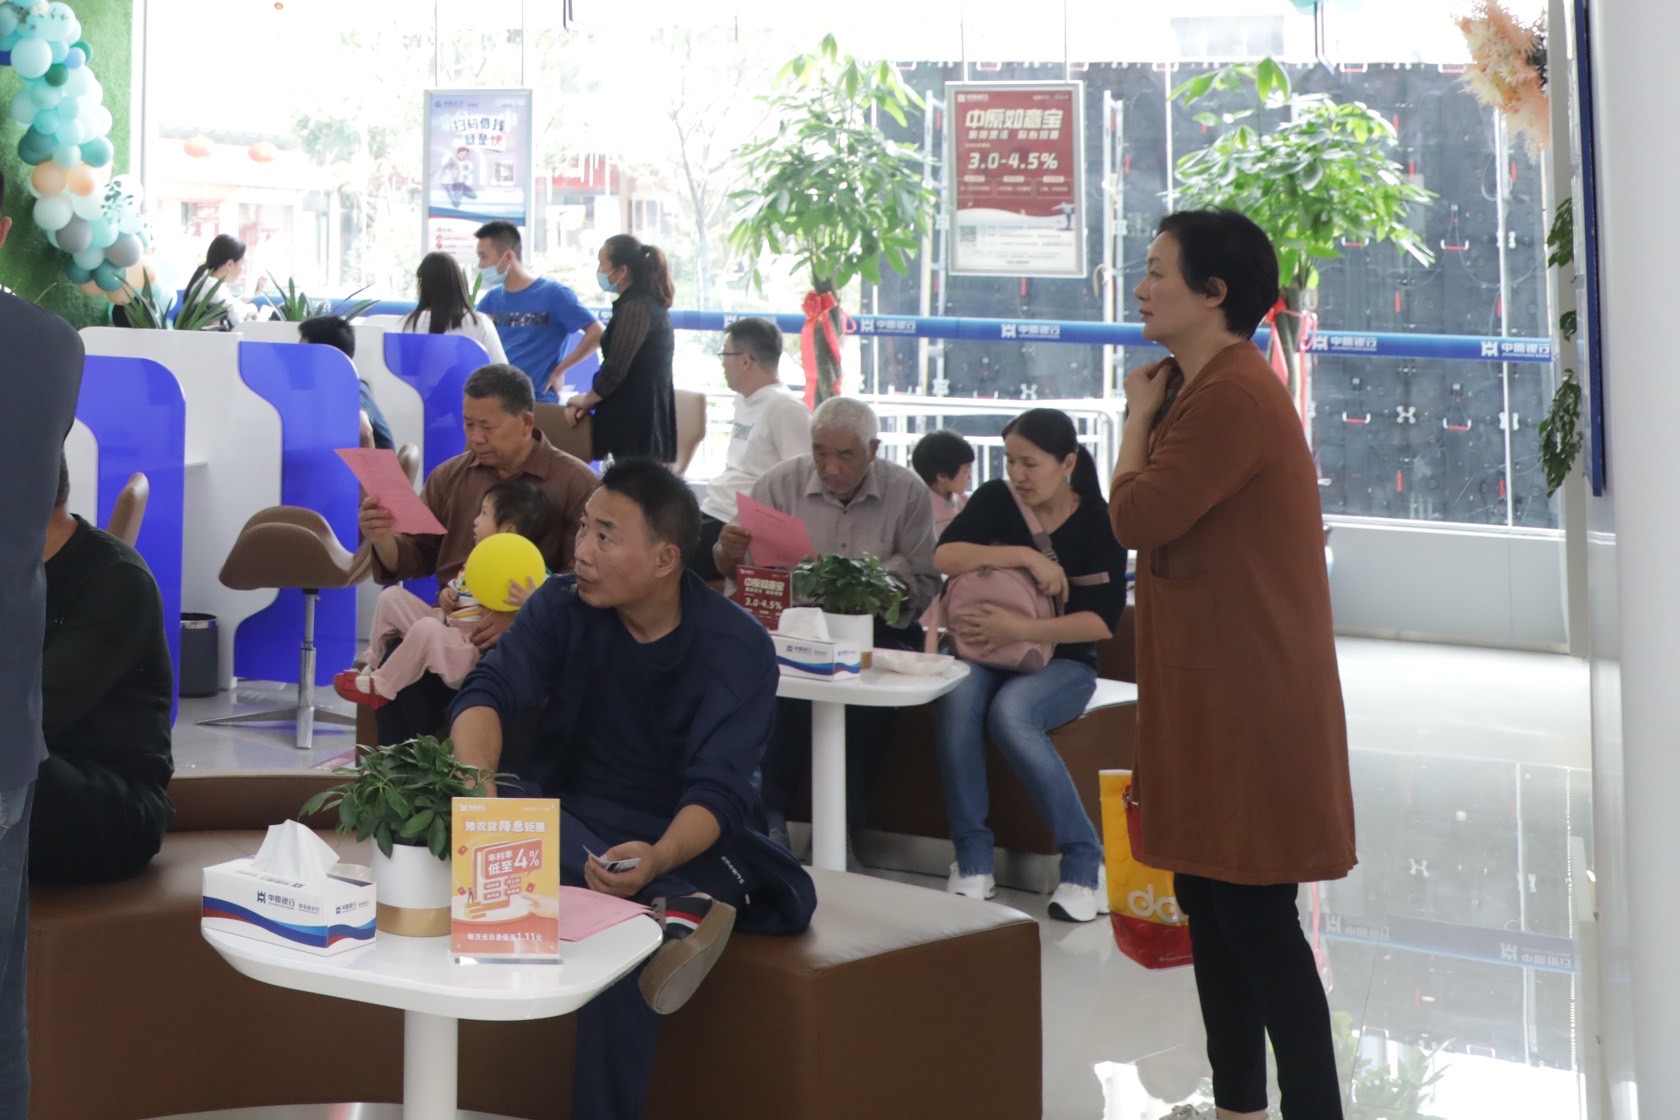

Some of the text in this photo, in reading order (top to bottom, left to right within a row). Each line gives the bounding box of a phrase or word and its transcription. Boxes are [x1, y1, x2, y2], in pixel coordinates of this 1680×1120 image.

[965, 108, 1064, 129] 中原如意宝
[968, 152, 1058, 169] 3.0-4.5%
